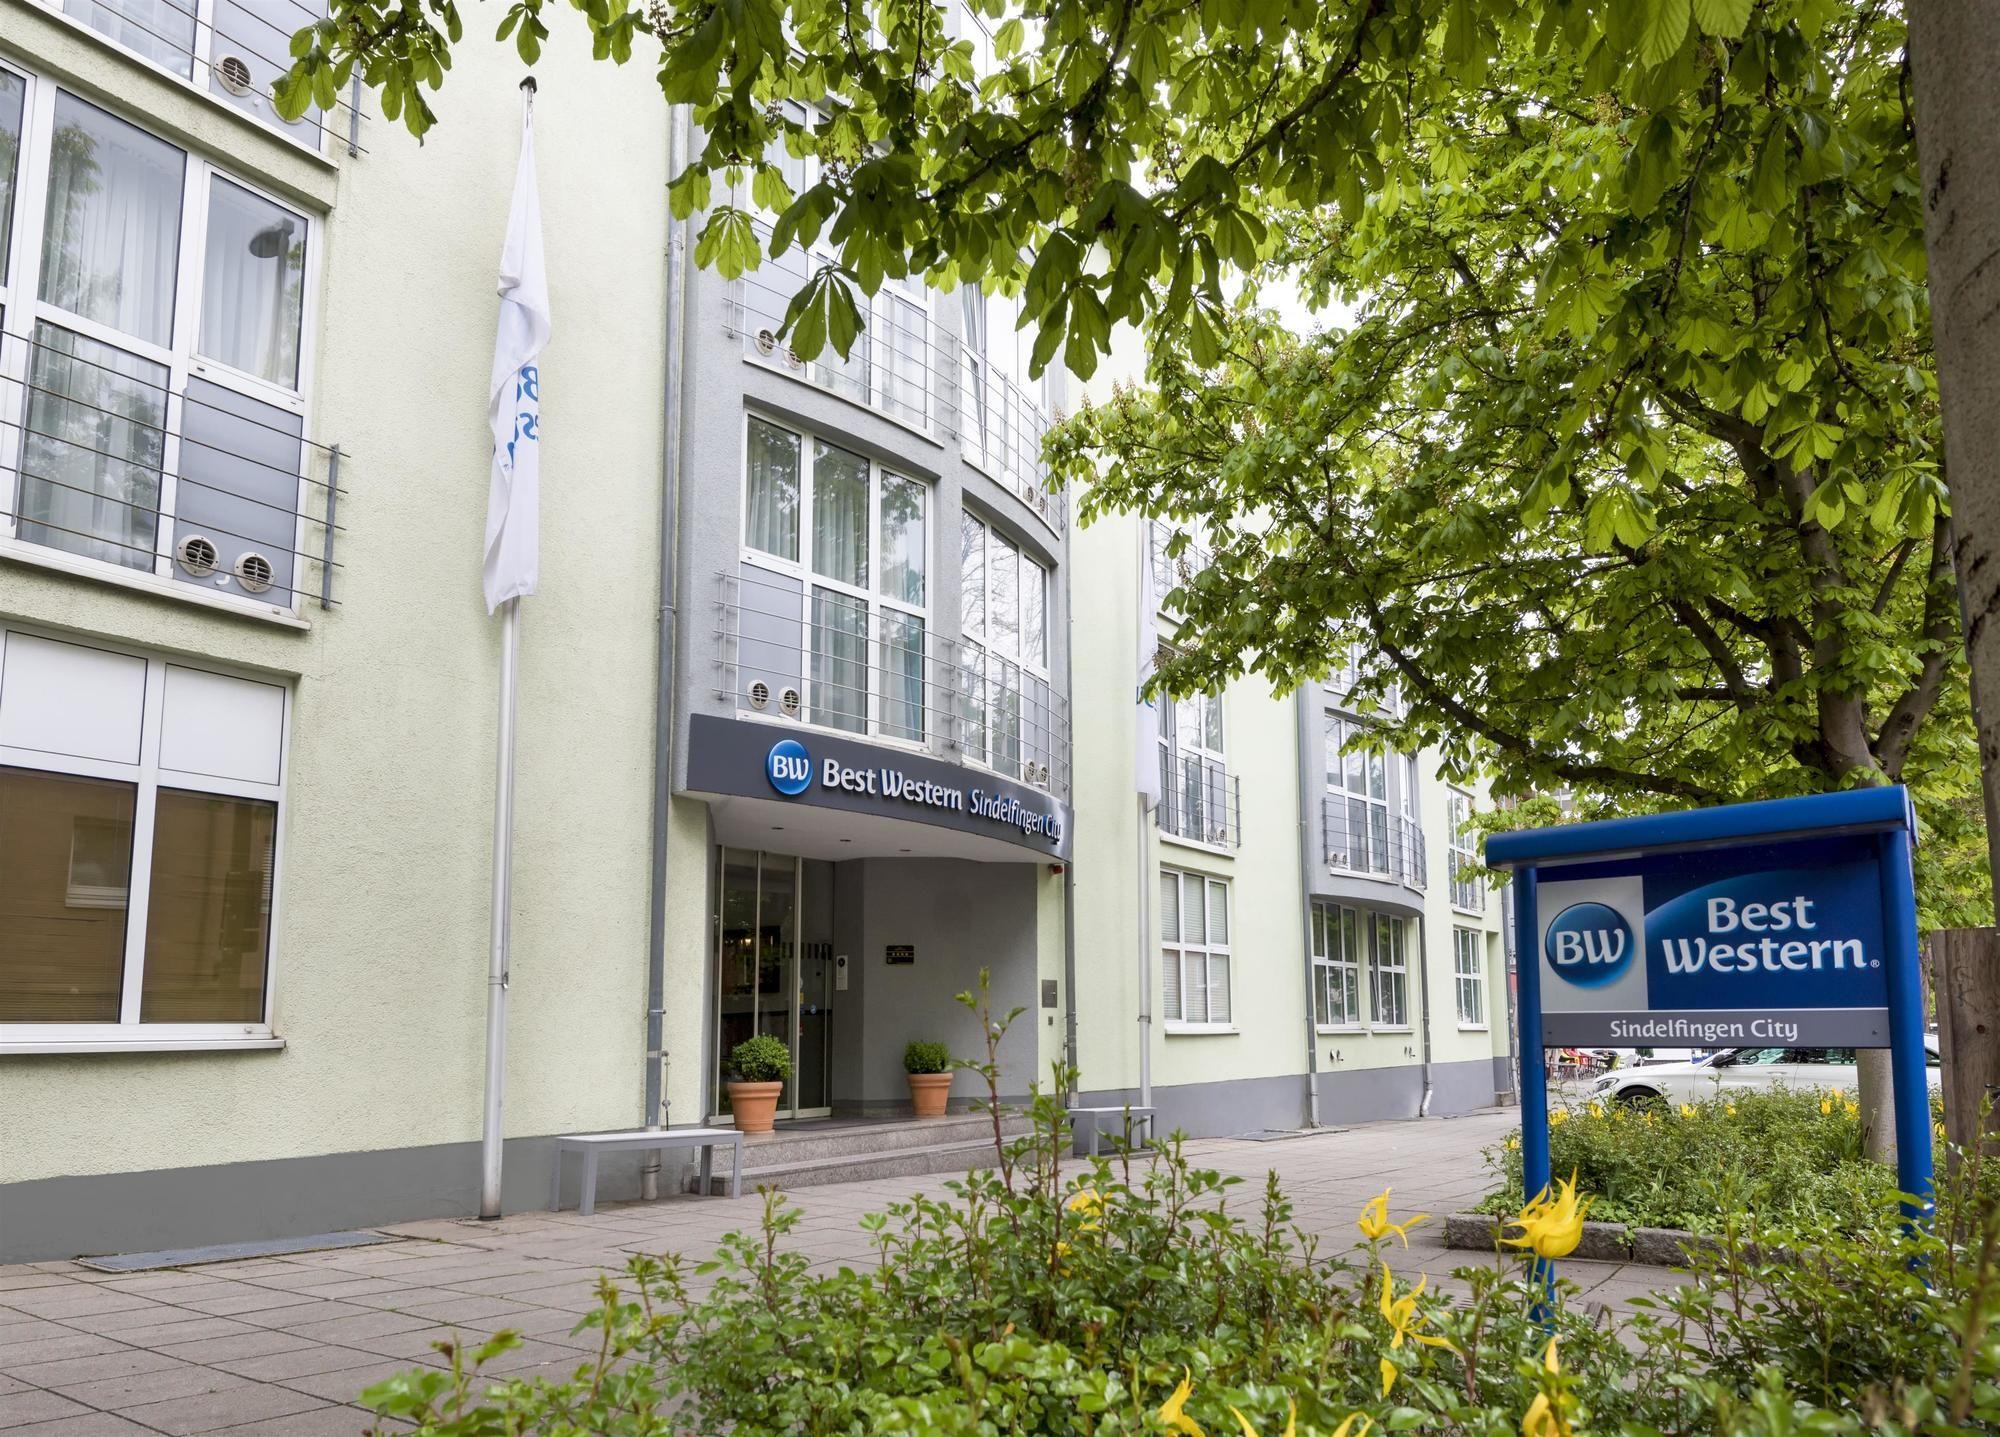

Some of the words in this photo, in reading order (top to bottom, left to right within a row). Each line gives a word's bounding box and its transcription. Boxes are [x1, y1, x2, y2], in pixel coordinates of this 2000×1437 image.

[772, 756, 809, 781] BW
[822, 758, 876, 794] Best
[882, 769, 963, 810] Western
[970, 788, 1044, 835] Sindelfingen
[1046, 814, 1064, 845] City
[1707, 895, 1816, 933] Best
[1555, 929, 1625, 965] BW
[1610, 1020, 1744, 1042] Sindelfingen
[1750, 1019, 1798, 1042] City
